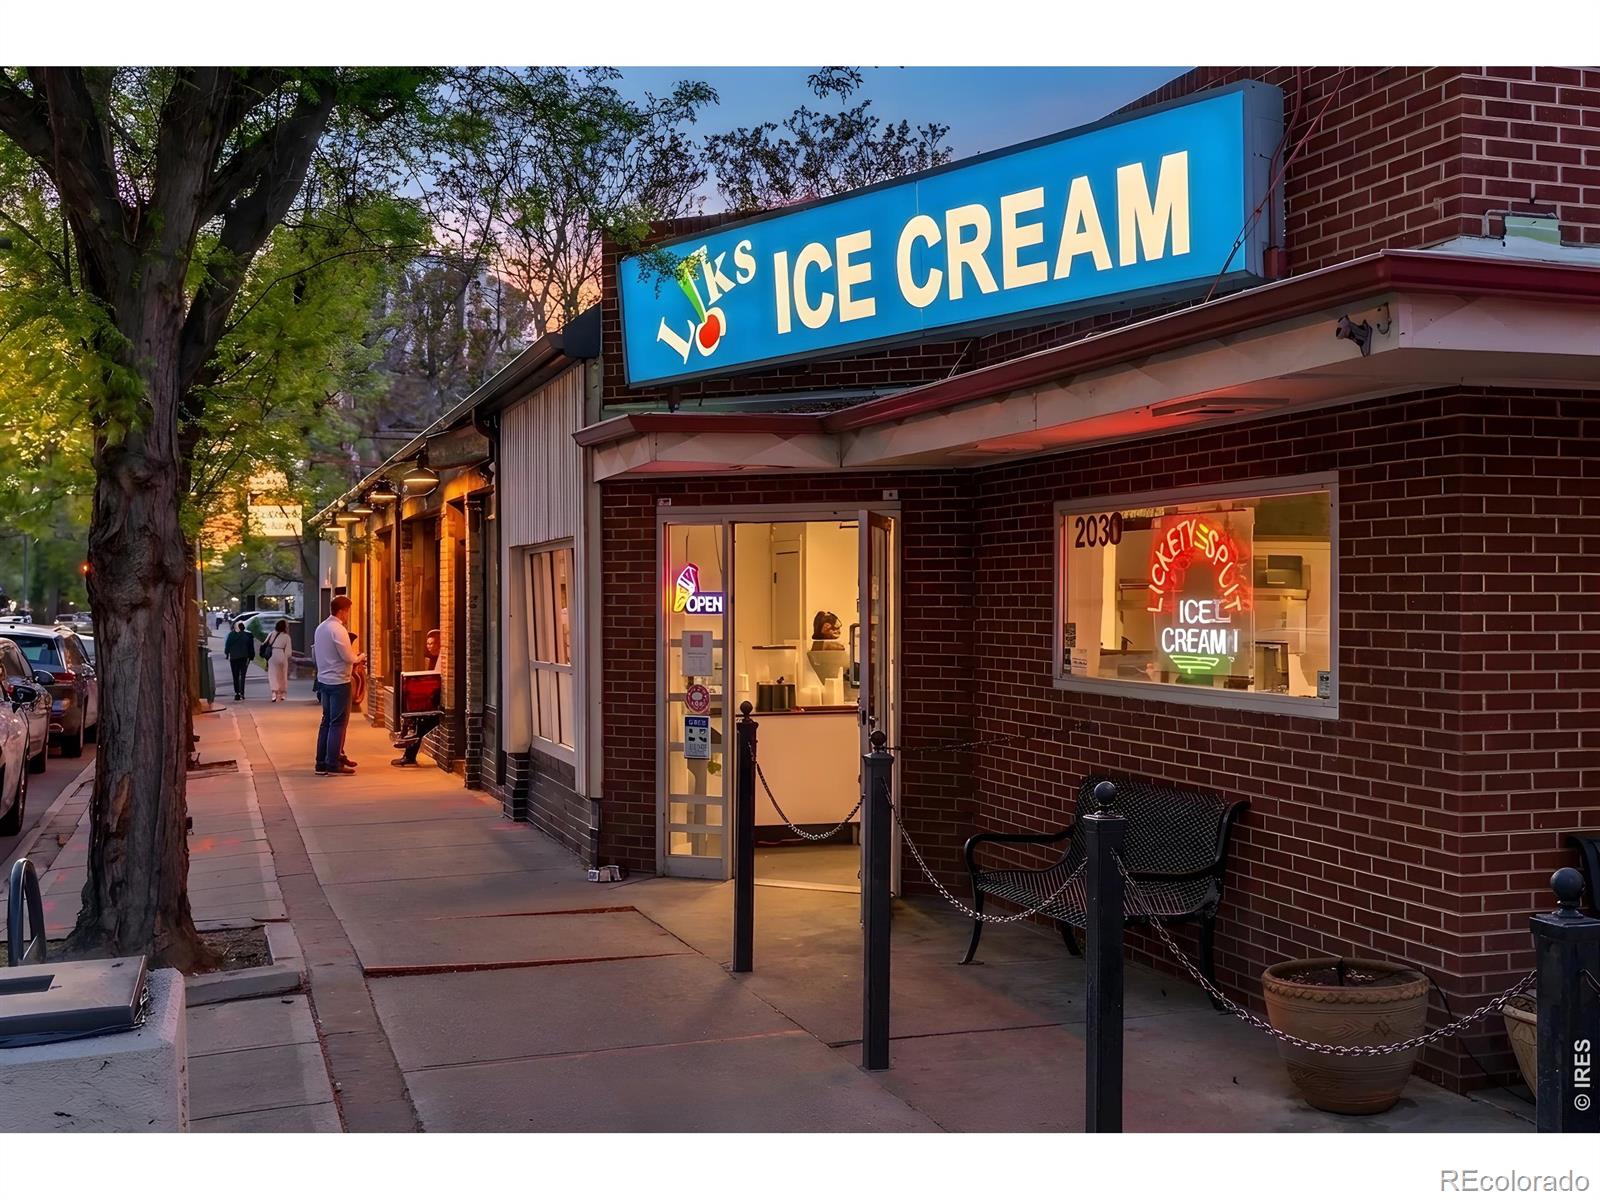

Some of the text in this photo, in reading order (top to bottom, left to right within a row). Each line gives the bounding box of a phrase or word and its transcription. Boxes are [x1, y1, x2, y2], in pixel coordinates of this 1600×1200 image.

[773, 229, 876, 334] ICE
[896, 151, 1190, 308] CREAM
[1075, 512, 1122, 548] 2030
[686, 595, 723, 612] OPEN
[1179, 599, 1213, 624] ICE
